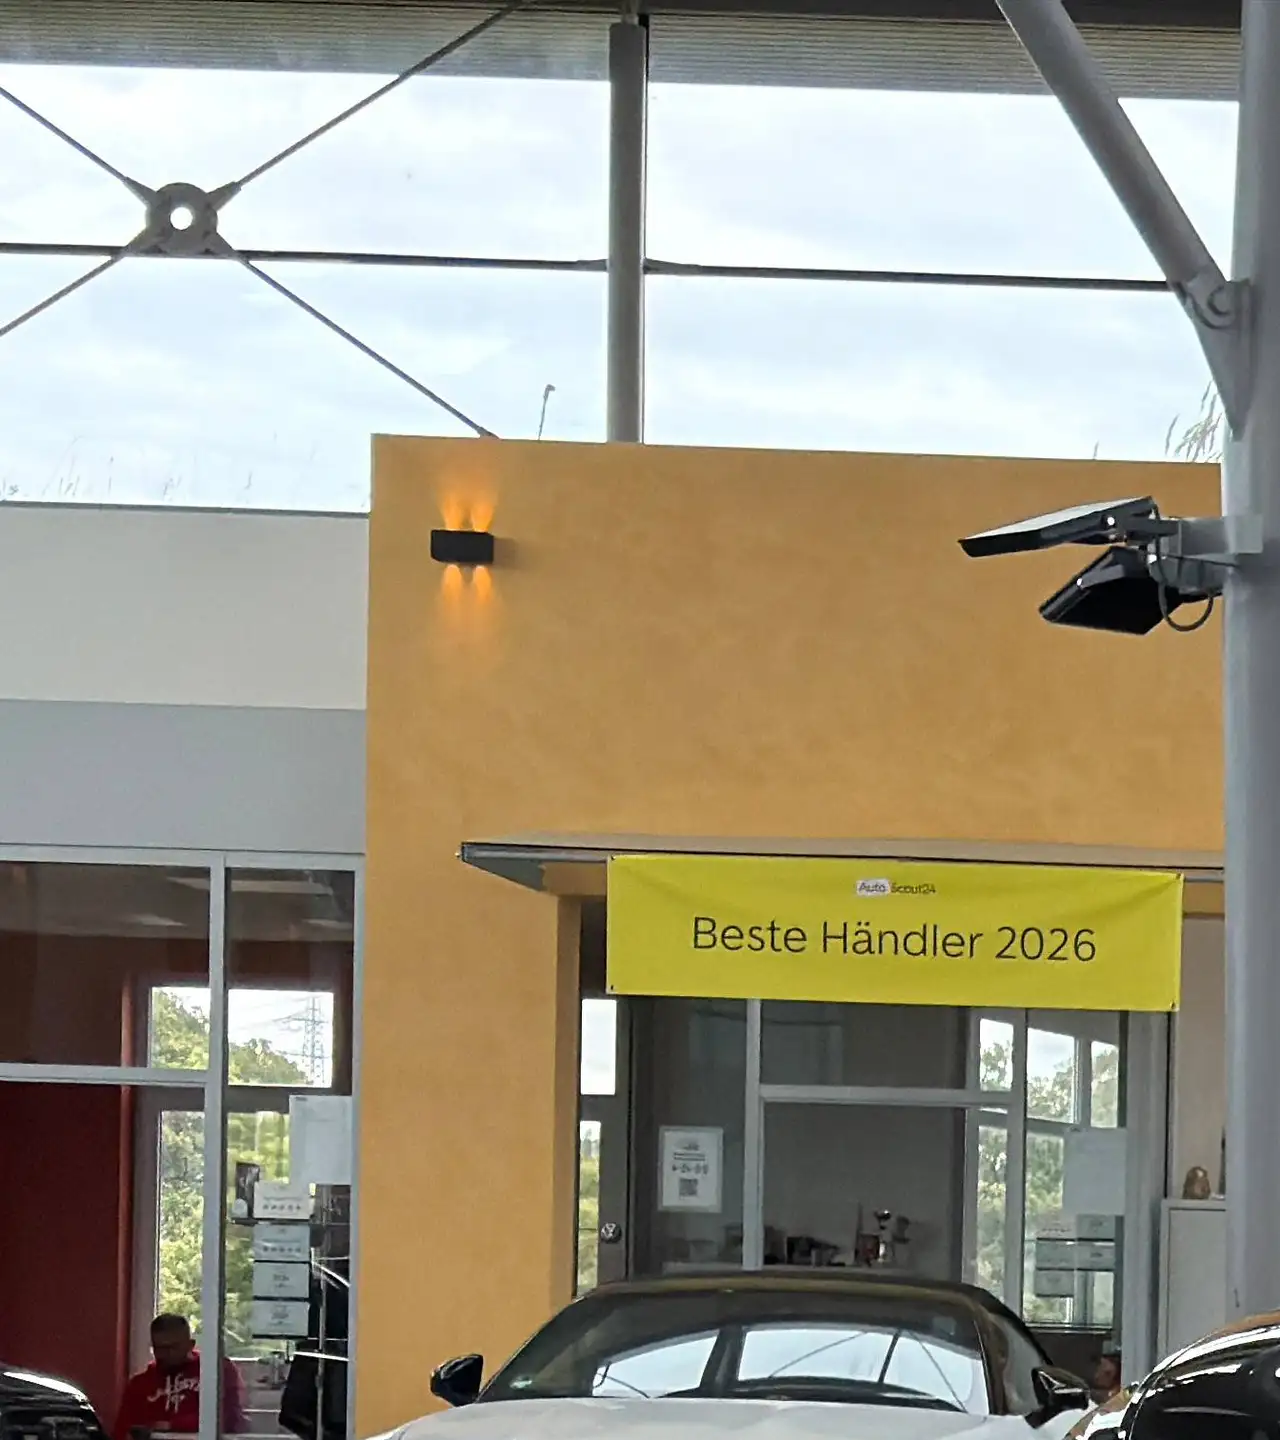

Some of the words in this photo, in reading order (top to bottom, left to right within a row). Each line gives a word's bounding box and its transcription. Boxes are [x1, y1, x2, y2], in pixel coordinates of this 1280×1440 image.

[692, 916, 808, 952] Beste
[822, 921, 983, 960] Händler
[994, 926, 1097, 962] 2026
